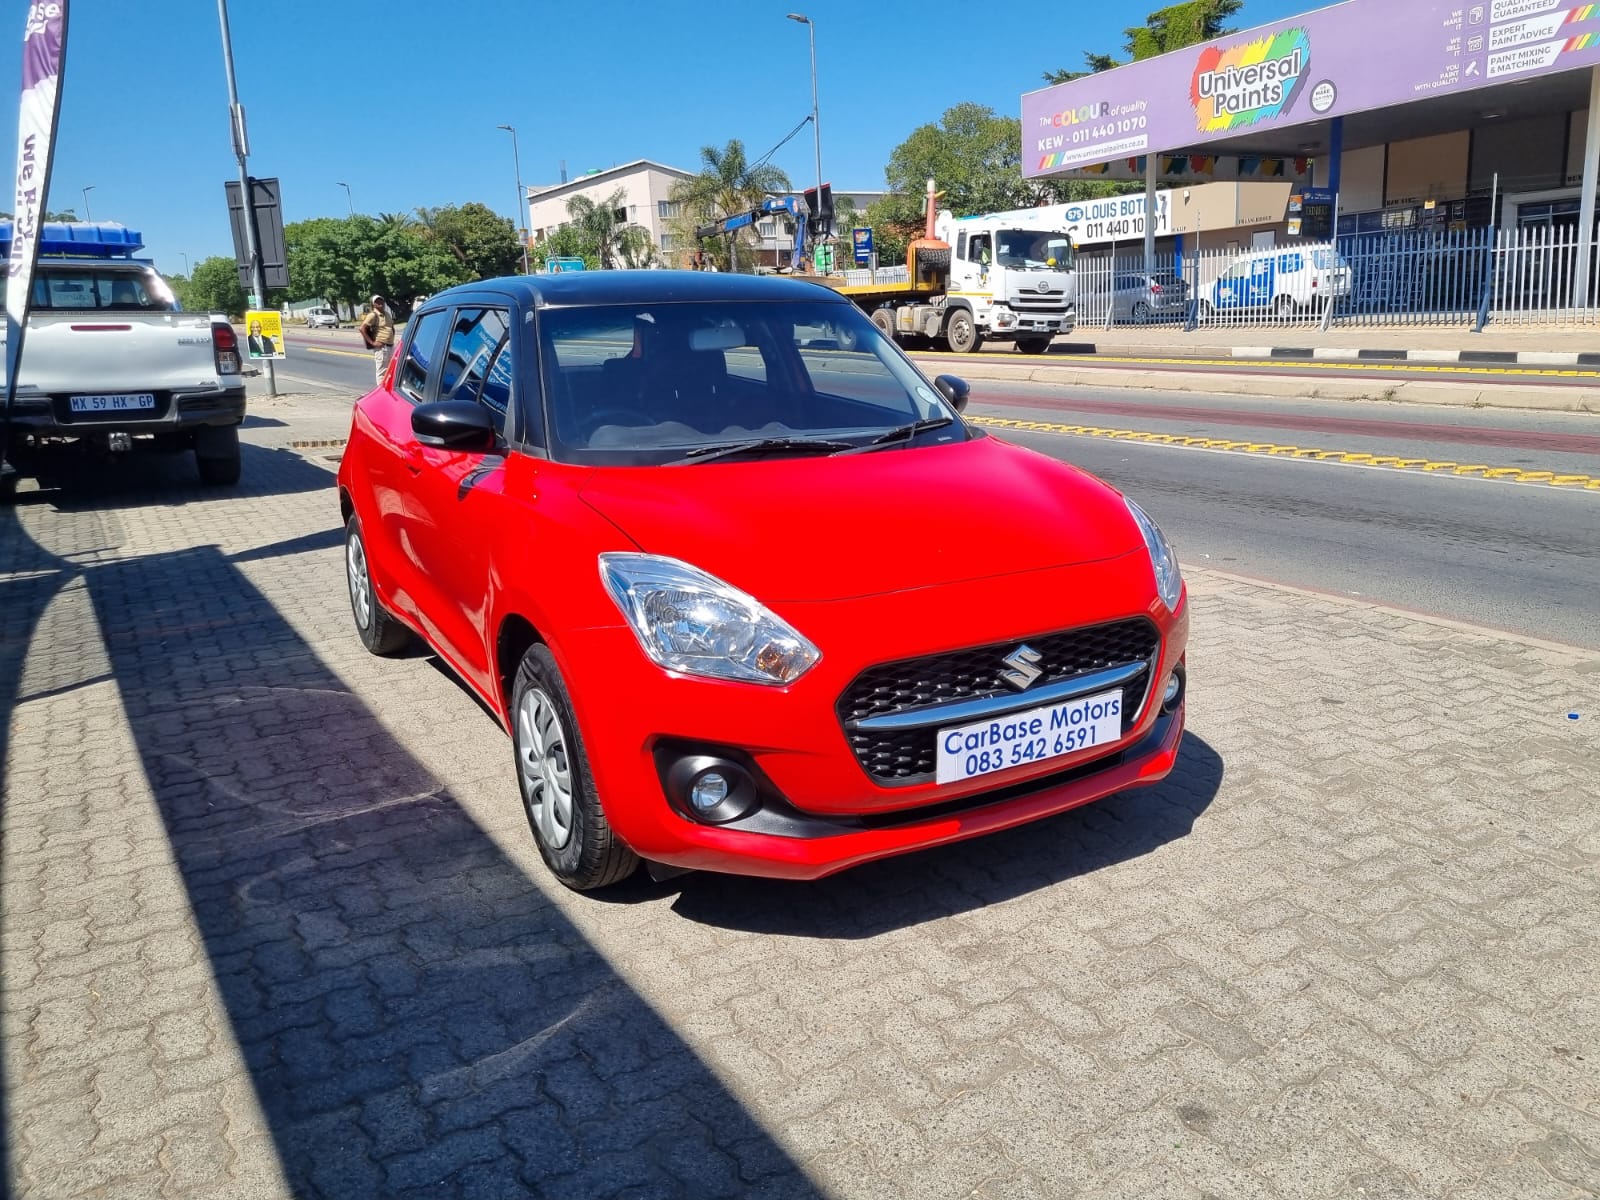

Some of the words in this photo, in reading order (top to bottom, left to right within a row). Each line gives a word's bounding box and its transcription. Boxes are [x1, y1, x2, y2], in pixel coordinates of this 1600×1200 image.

[1493, 0, 1555, 19] GUARANTEED
[1491, 35, 1518, 47] PAINT
[1520, 26, 1553, 41] ADVICE
[1492, 24, 1527, 38] EXPERT
[1490, 54, 1516, 66] PAINT
[1518, 46, 1551, 59] MIXING
[1497, 57, 1545, 72] MATCHING
[1200, 51, 1299, 96] Universal
[1440, 70, 1460, 79] PAINT
[1446, 64, 1460, 72] YOU
[1414, 81, 1431, 91] WITH
[1431, 77, 1459, 89] QUALITY
[1215, 83, 1281, 115] Paints
[1039, 116, 1052, 127] The
[1052, 101, 1109, 128] COLOUR
[1111, 106, 1121, 117] of
[1121, 100, 1148, 116] quality
[1038, 135, 1064, 152] KEW
[1073, 128, 1090, 144] 011
[1092, 122, 1115, 139] 440
[1117, 115, 1147, 134] 1070
[1066, 139, 1145, 162] www.universalpaints.co.za
[1085, 202, 1117, 220] LOUIS
[1086, 222, 1104, 239] 011
[1106, 219, 1129, 236] 440
[93, 397, 106, 409] 59
[113, 396, 128, 409] HX
[139, 395, 153, 407] GP
[944, 718, 1042, 755] CarBase
[1050, 699, 1120, 731] Motors
[965, 748, 1004, 776] 083
[1010, 737, 1047, 764] 542
[1053, 725, 1097, 754] 6591
